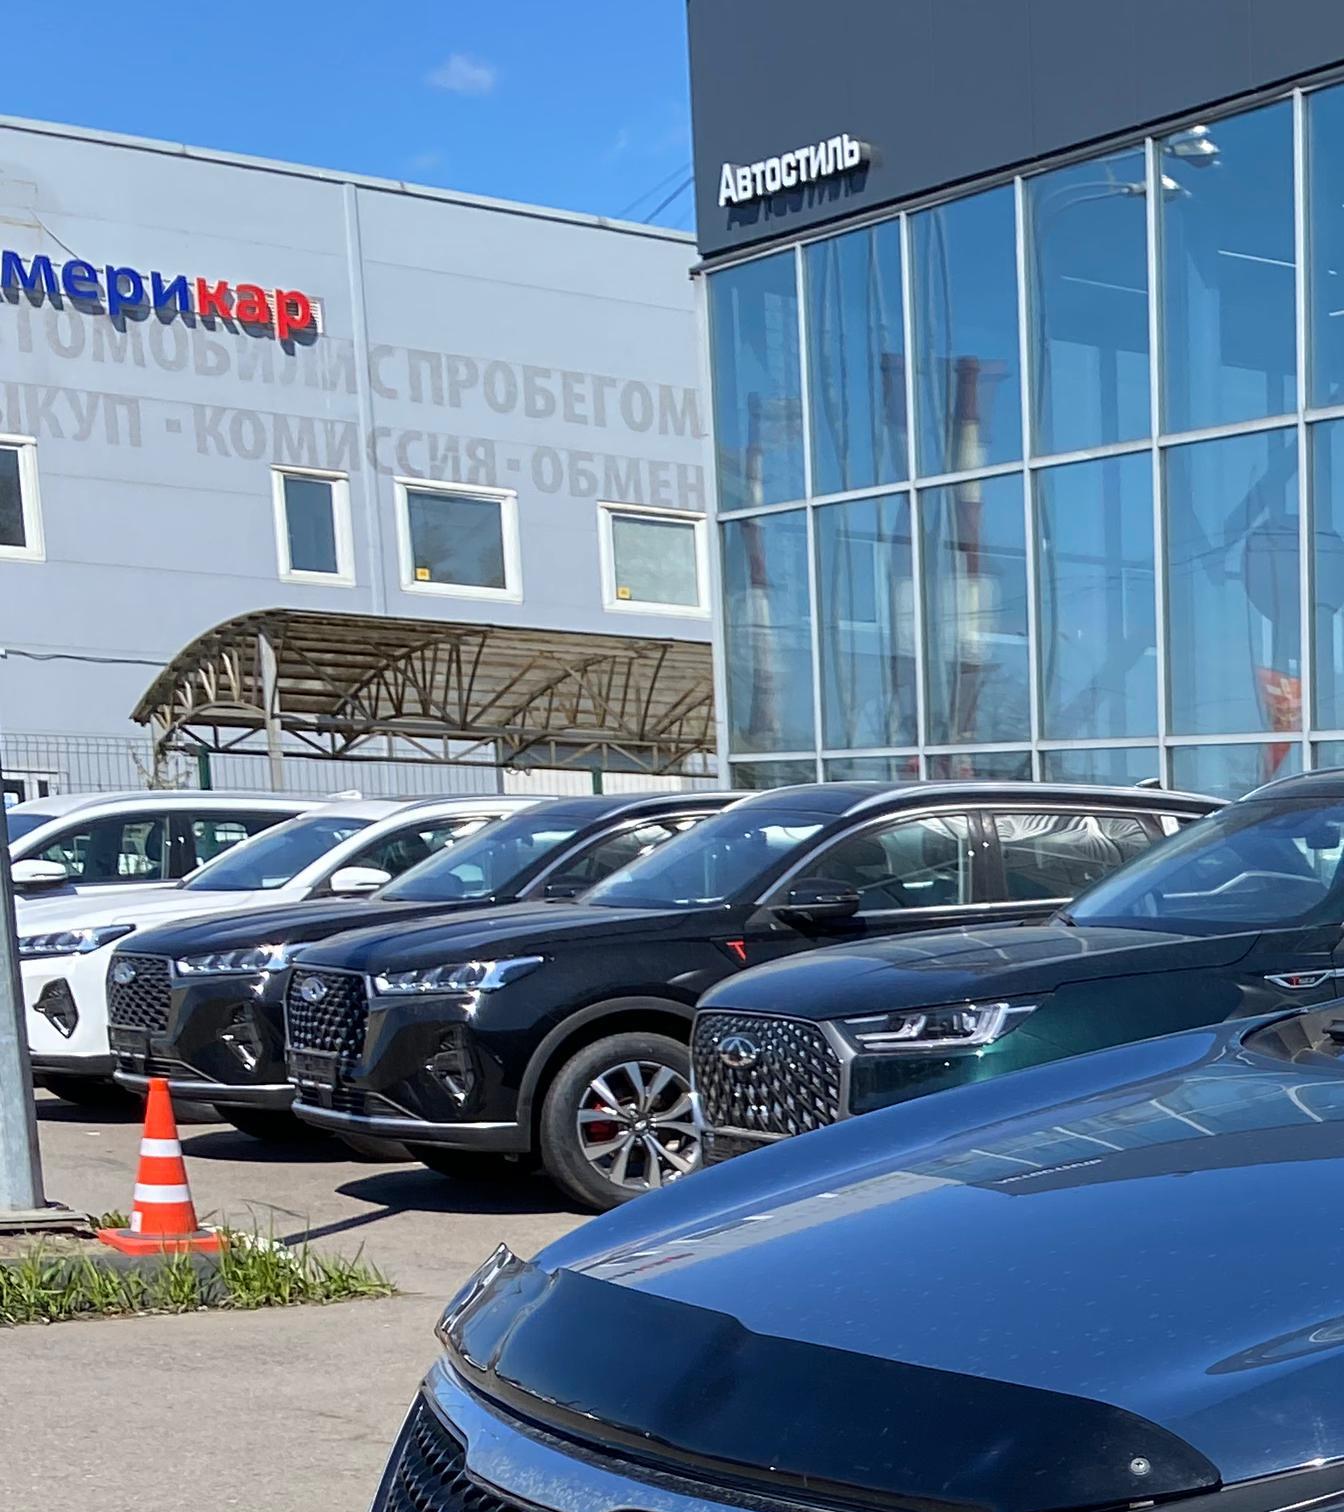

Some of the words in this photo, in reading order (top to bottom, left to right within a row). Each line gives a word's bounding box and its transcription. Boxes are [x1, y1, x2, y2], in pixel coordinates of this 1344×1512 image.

[0, 251, 312, 340] мерикар
[407, 349, 704, 439] ПРОБЕГОМ
[530, 446, 706, 511] ОБМЕН
